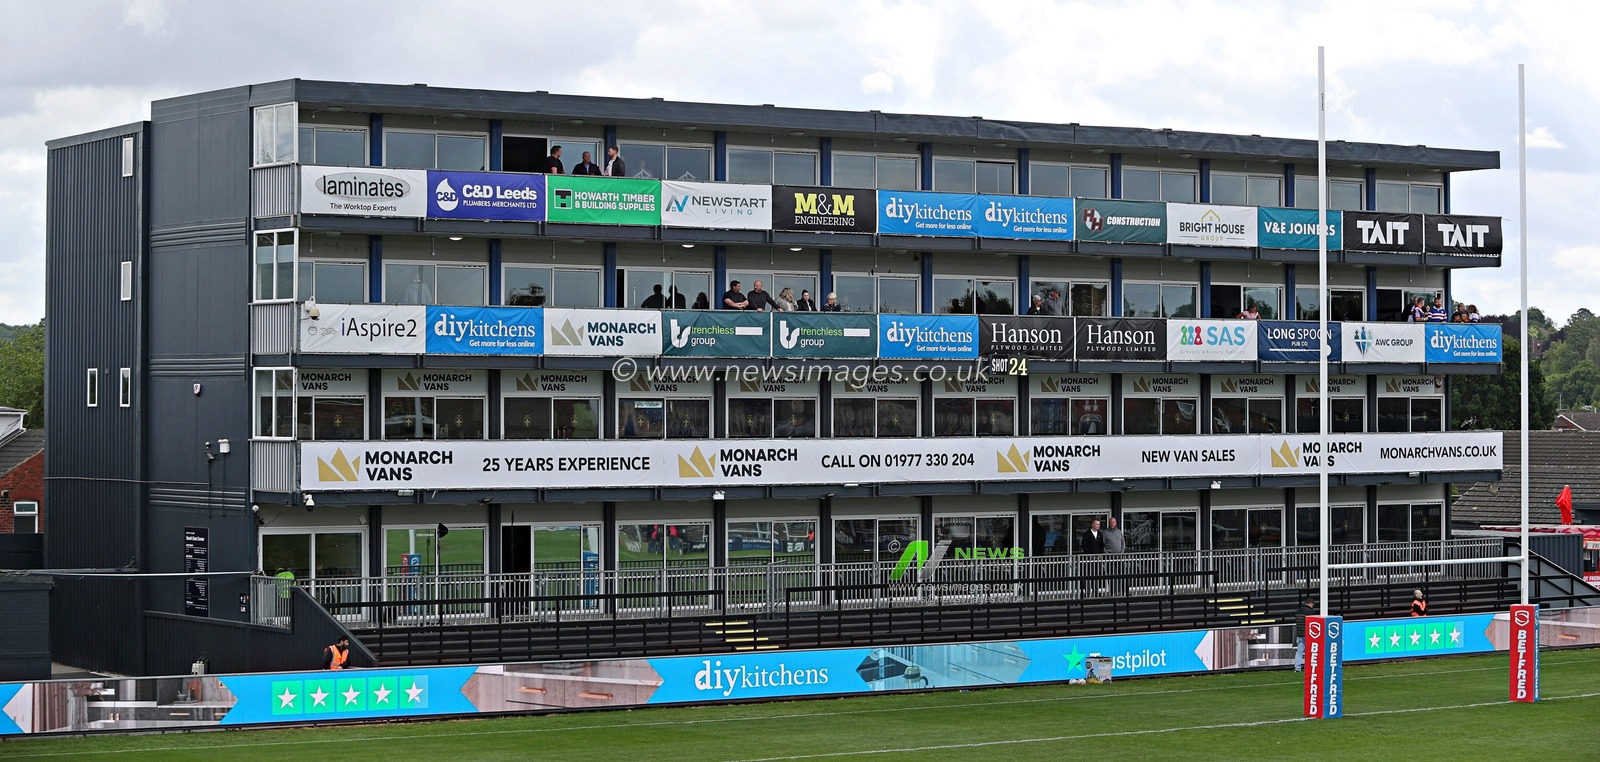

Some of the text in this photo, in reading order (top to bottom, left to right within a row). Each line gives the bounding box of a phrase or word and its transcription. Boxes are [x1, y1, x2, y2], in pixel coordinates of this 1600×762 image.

[323, 175, 404, 198] laminates
[462, 184, 538, 201] C&D Leeds
[437, 191, 458, 201] C&D
[575, 191, 655, 203] HOWARTH TIMBER
[692, 195, 768, 208] NEWSTART
[343, 203, 371, 212] Worktop
[373, 204, 397, 212] Experts
[463, 199, 491, 207] PLUMBERS
[492, 201, 526, 209] MERCHANTS
[582, 201, 617, 210] BUILDING
[619, 203, 656, 211] SUPPLIES
[794, 193, 854, 215] M&M
[886, 198, 972, 224] diykitchens
[985, 202, 1068, 227] diykitchens
[795, 215, 854, 226] ENGINEERING
[916, 222, 972, 230] Get more for less online
[1107, 216, 1161, 227] CONSTRUCTION
[1013, 226, 1067, 234] Get more for less online
[1180, 221, 1245, 234] BRIGHT HOUSE
[1264, 222, 1286, 234] V&E
[1356, 220, 1410, 244] TAIT
[1437, 223, 1490, 247] TAIT
[341, 317, 417, 341] iAspire2
[434, 314, 535, 342] diykitchens
[587, 322, 656, 334] MONARCH
[691, 325, 734, 335] trenchless
[800, 327, 843, 336] trenchless
[887, 321, 972, 347] diykitchens
[991, 323, 1062, 344] Hanson
[1087, 324, 1155, 345] Hanson
[1267, 328, 1295, 340] LONG
[589, 335, 624, 347] VANS
[691, 337, 716, 347] group
[1206, 326, 1246, 346] SAS
[1430, 330, 1497, 352] diykitchens
[470, 340, 535, 348] Get more for less online
[800, 338, 824, 348] group
[916, 344, 924, 353] Get
[925, 344, 938, 353] more
[947, 344, 957, 353] less
[957, 344, 972, 353] online
[1375, 339, 1414, 347] AWC GROUP
[991, 358, 1028, 376] SHOT 24
[301, 373, 352, 381] MONARCH
[423, 374, 472, 382] MONARCH
[540, 374, 587, 382] MONARCH
[1060, 378, 1098, 386] MONARCH
[1152, 378, 1188, 386] MONARCH
[1239, 378, 1274, 386] MONARCH
[1033, 445, 1100, 458] MONARCH
[1302, 441, 1362, 453] MOARCH
[1380, 446, 1497, 459] MONARCHVANS.CO.UK
[365, 451, 453, 464] MONARCH
[720, 448, 798, 462] MONARCH
[821, 453, 974, 468] CALL ON 01977 330 204
[1141, 449, 1235, 463] NEW VAN SALES
[1303, 455, 1335, 467] VAS
[482, 456, 650, 471] 25 YEARS EXPERIENCE
[1034, 459, 1070, 472] VANS
[366, 467, 412, 481] VANS
[721, 464, 762, 477] VANS
[1090, 649, 1167, 672] stpilot
[1516, 629, 1527, 699] BETFRED
[694, 660, 829, 697] diykitchens
[1309, 642, 1319, 716] BETFRED
[1329, 642, 1338, 716] BETFRED
